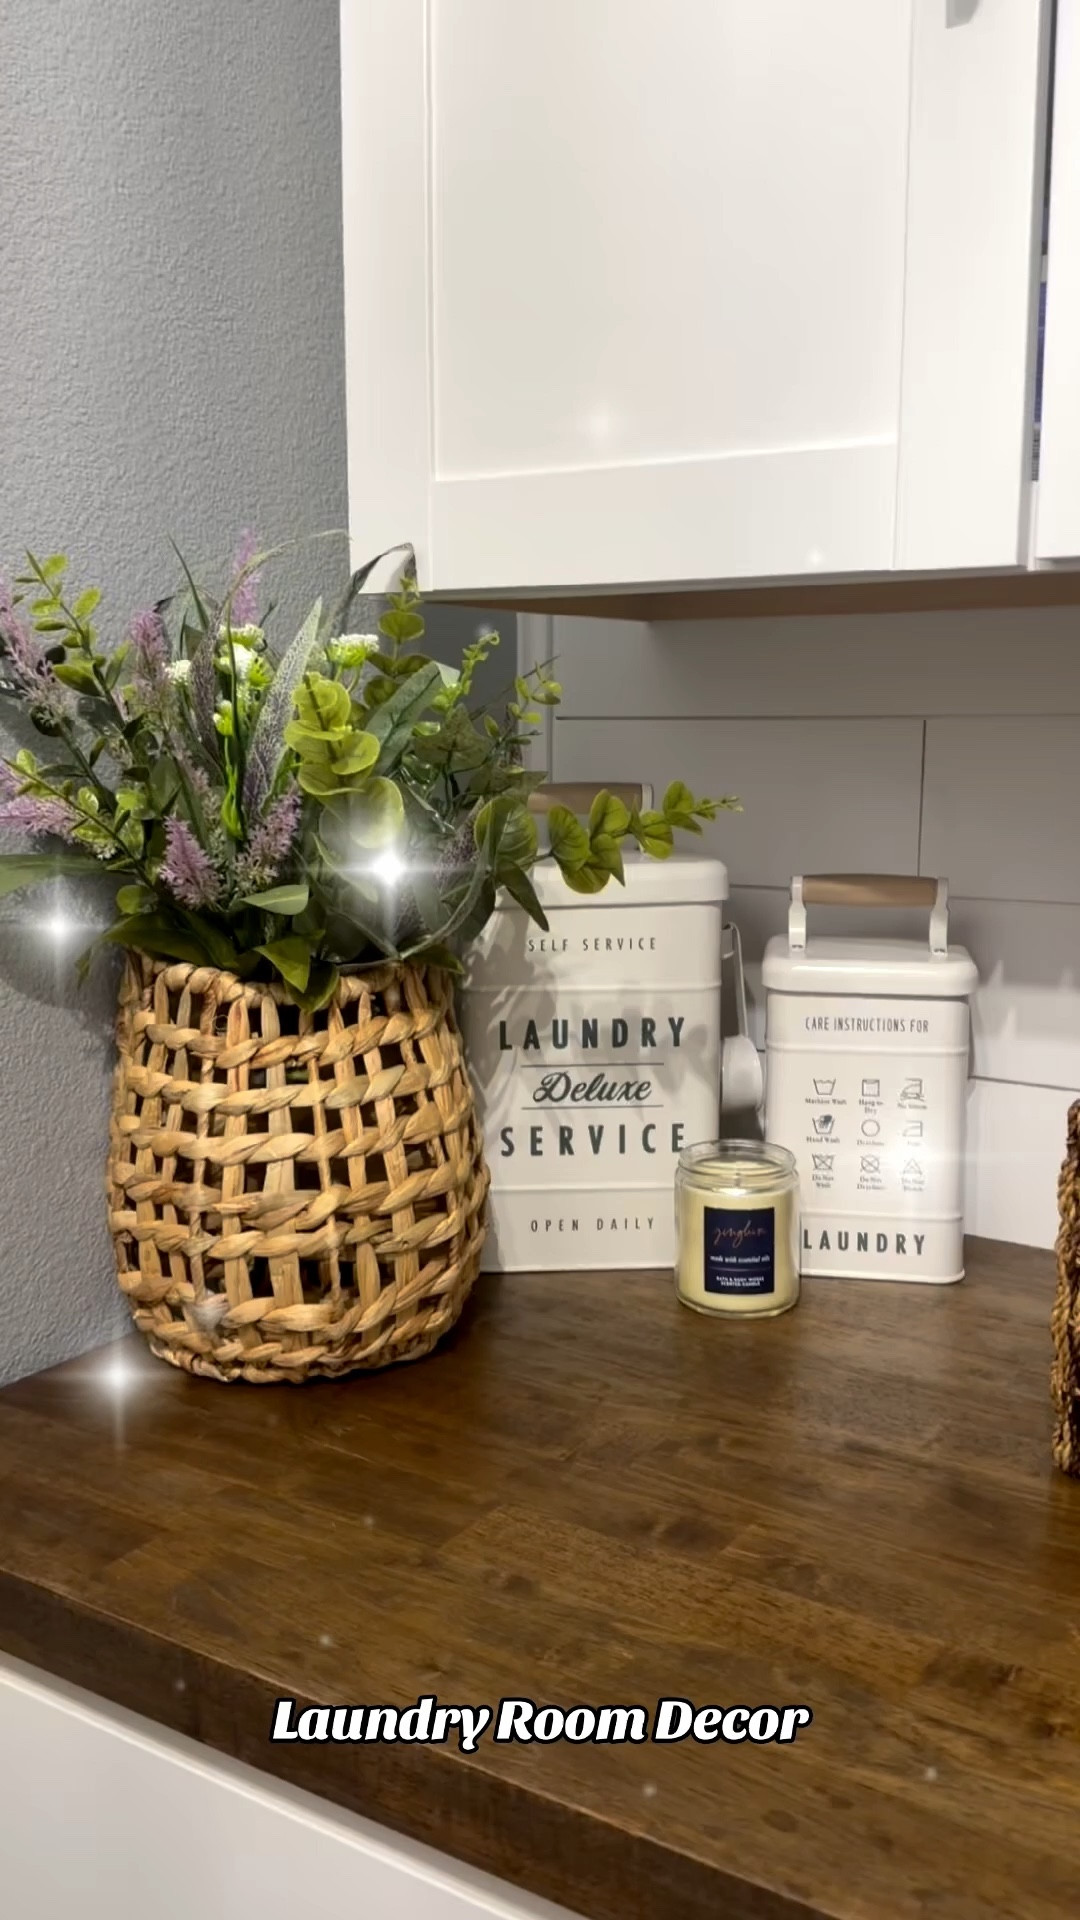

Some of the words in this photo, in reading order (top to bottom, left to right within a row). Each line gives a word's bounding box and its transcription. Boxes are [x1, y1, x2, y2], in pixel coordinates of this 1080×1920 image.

[528, 938, 569, 952] SELF
[583, 937, 657, 951] SERVICE
[499, 1016, 685, 1050] LAUNDRY
[805, 1016, 830, 1031] CARE
[833, 1016, 906, 1033] INSTRUCTIONS
[910, 1018, 930, 1033] FOR
[532, 1071, 652, 1102] Deluxe
[500, 1123, 686, 1157] SERVICE
[530, 1219, 579, 1233] OPEN
[596, 1217, 655, 1231] DAILY
[803, 1228, 925, 1256] LAUNDRY
